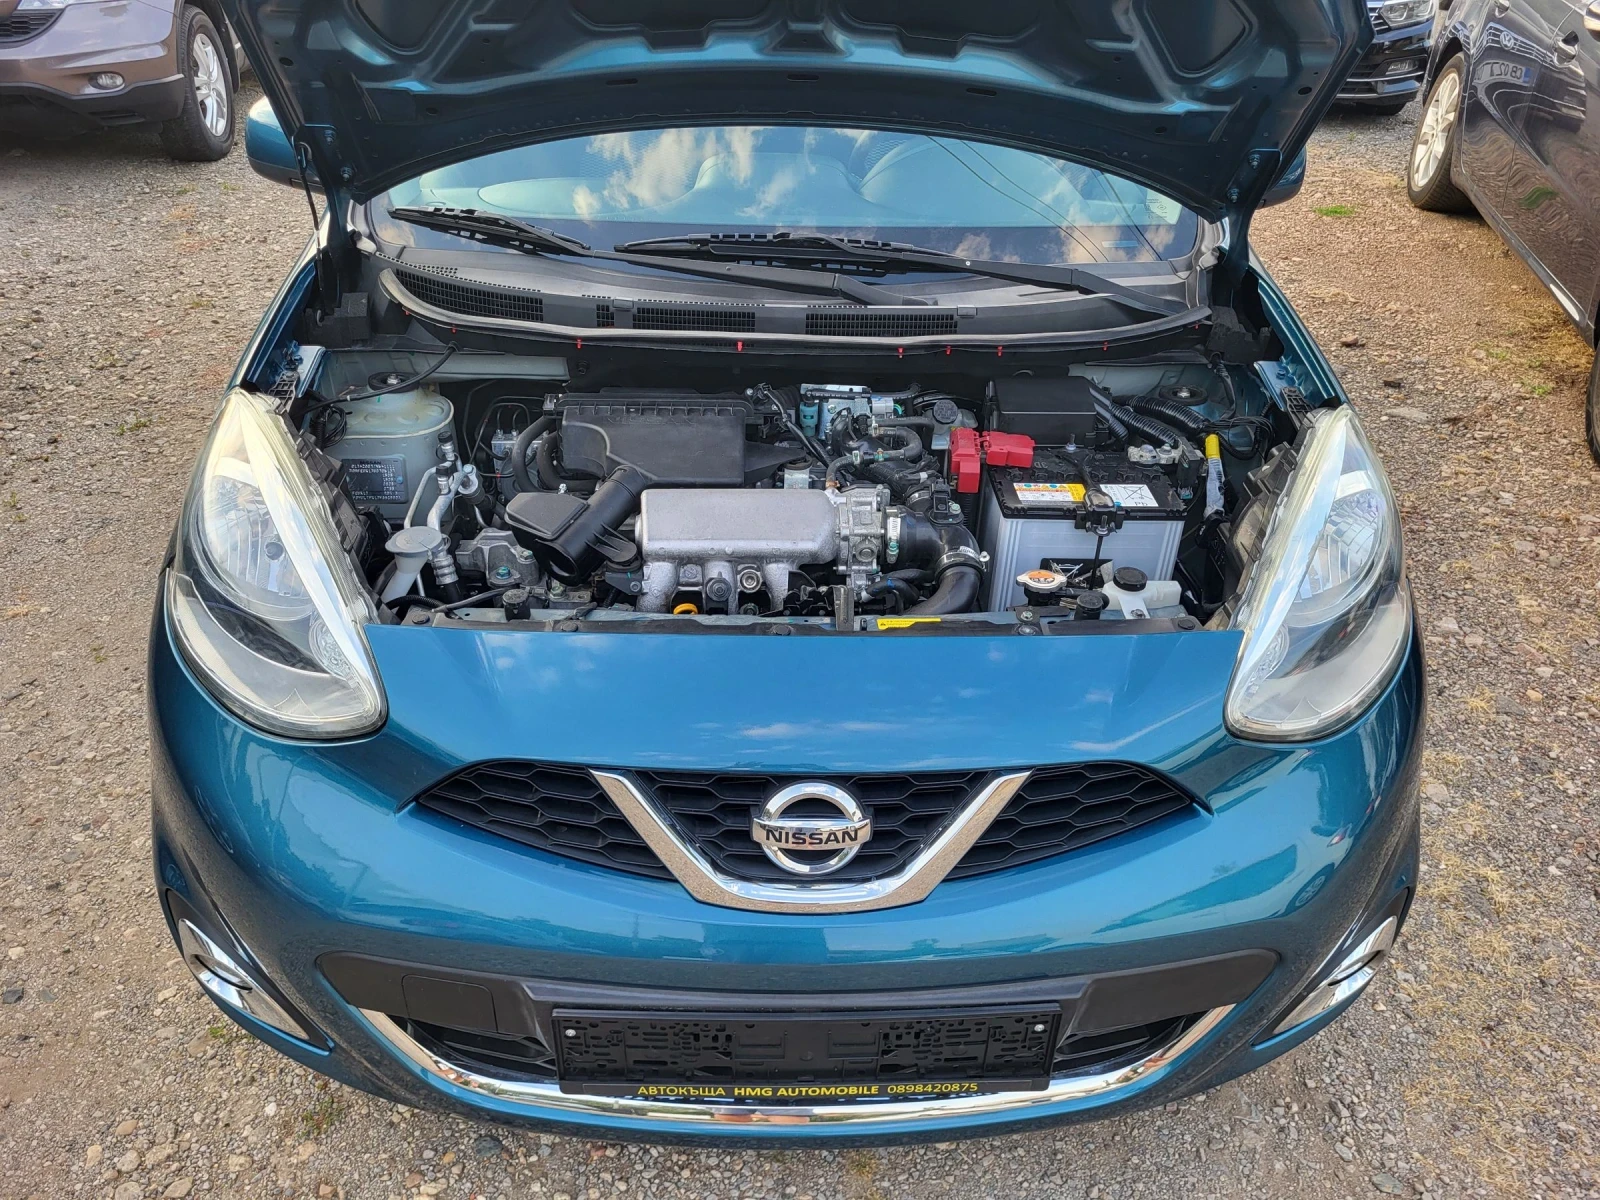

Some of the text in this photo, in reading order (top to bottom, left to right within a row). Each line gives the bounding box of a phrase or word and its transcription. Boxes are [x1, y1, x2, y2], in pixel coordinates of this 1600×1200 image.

[765, 829, 858, 845] NISSAN
[637, 1082, 978, 1097] АВТОКЪЩА HMG AUTOMOBILE 0898420875
